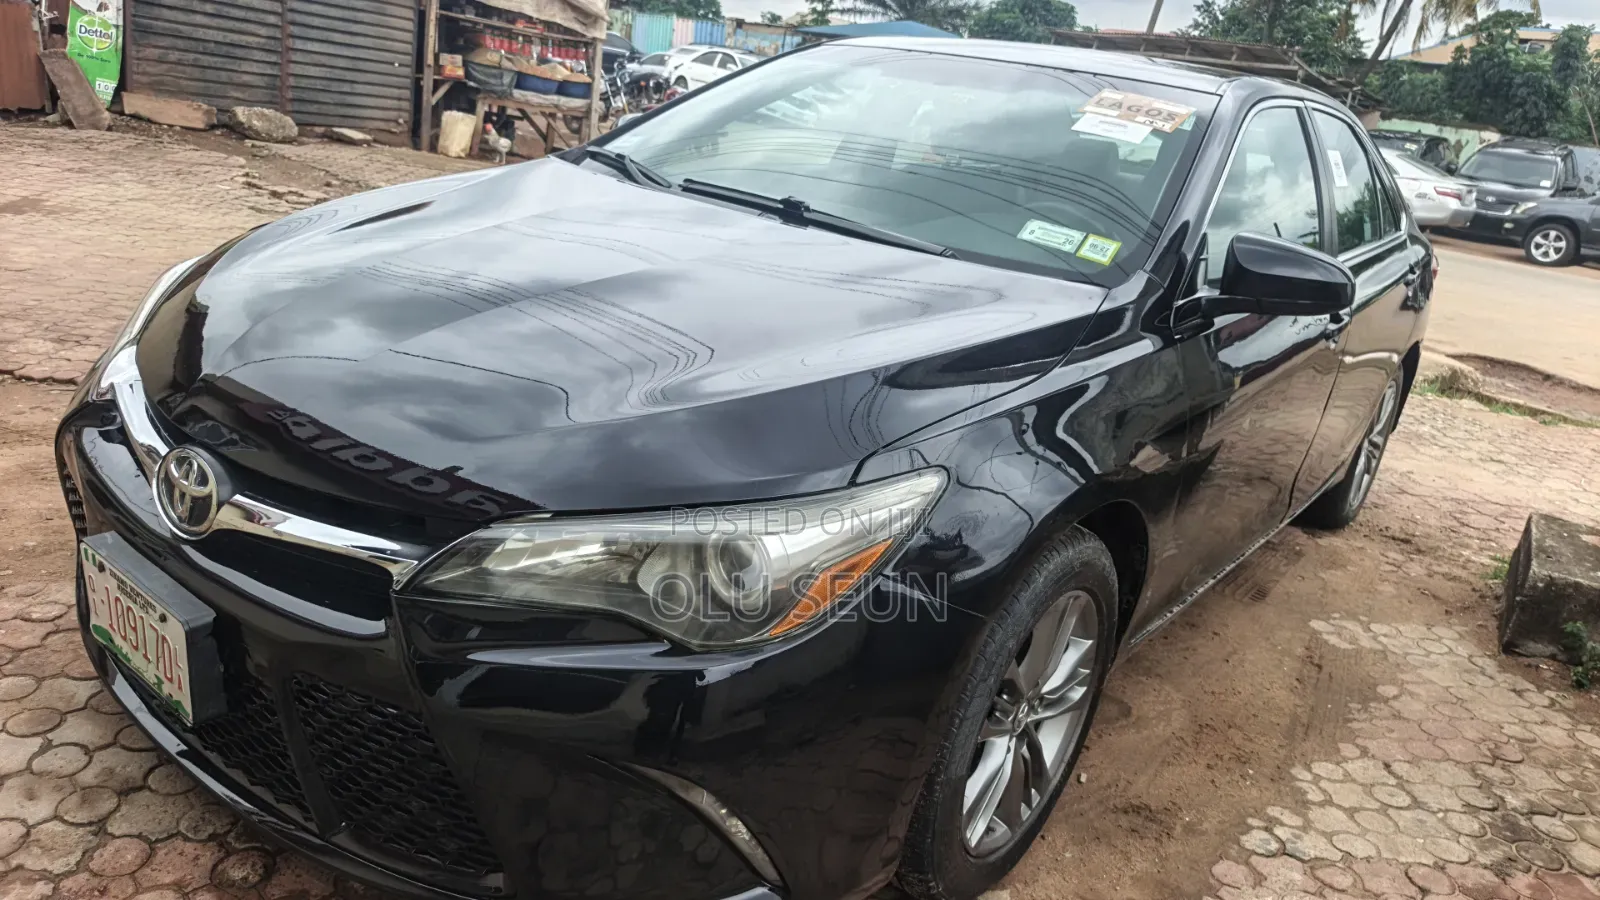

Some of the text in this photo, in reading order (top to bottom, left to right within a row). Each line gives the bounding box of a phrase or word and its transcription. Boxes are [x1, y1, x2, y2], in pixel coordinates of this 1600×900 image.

[79, 24, 113, 41] Dettol
[1093, 97, 1178, 122] LAGOS
[1063, 238, 1075, 246] 26
